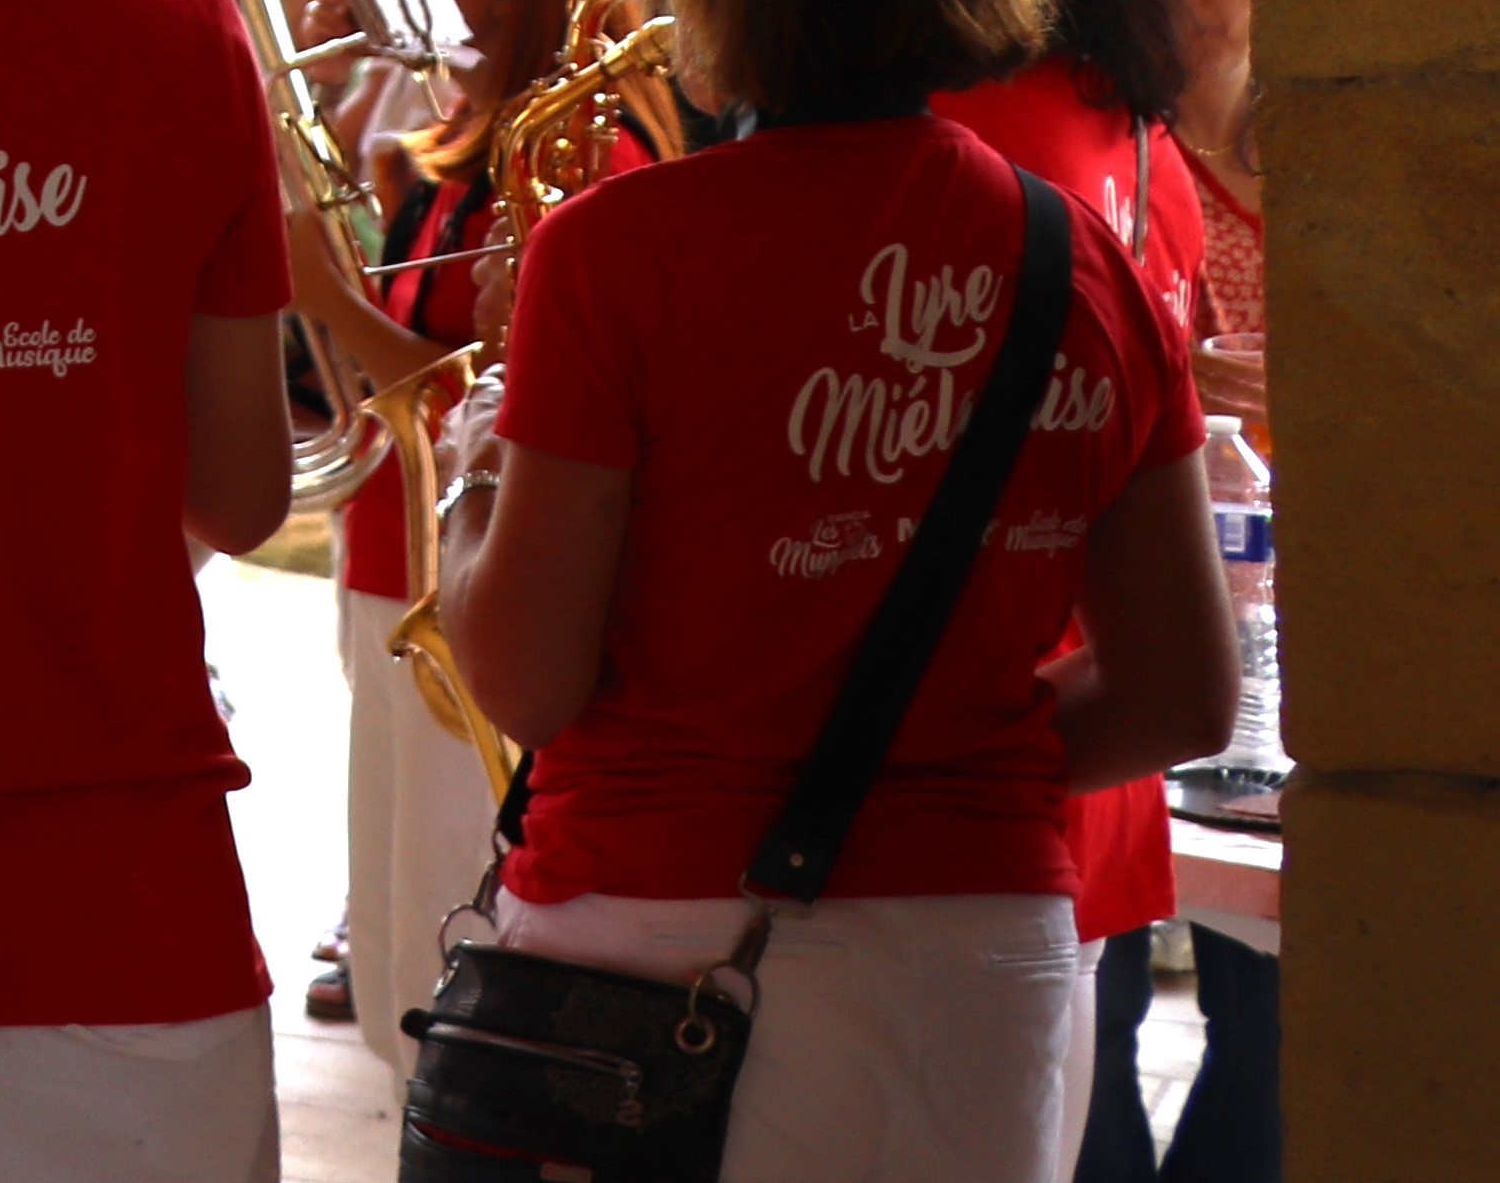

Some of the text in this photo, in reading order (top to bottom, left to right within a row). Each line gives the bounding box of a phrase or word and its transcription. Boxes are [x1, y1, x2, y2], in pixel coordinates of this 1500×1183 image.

[2, 318, 98, 348] Ecole de
[848, 242, 1004, 373] LA Lyre
[787, 353, 1116, 485] Miélise
